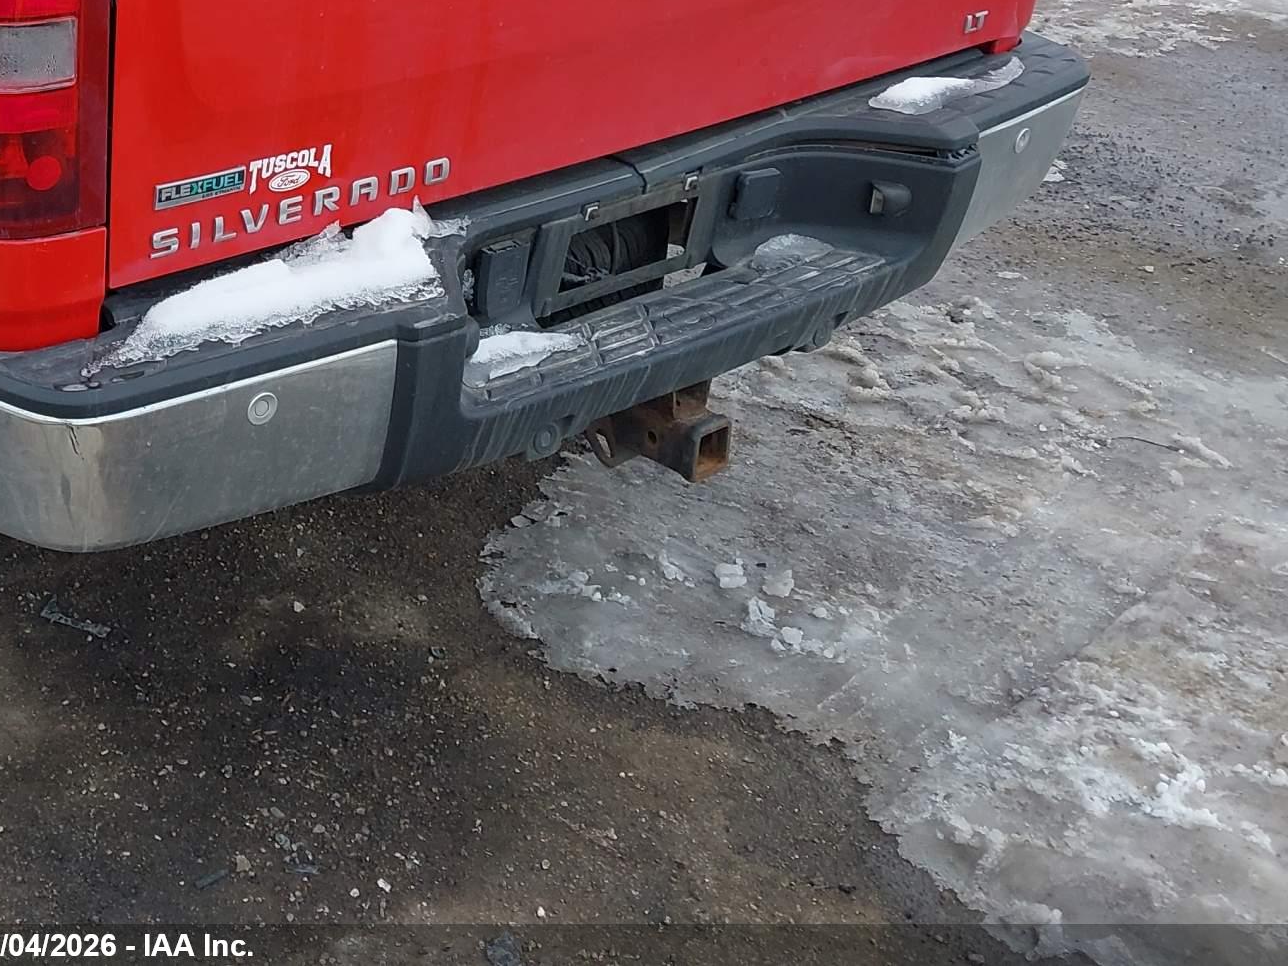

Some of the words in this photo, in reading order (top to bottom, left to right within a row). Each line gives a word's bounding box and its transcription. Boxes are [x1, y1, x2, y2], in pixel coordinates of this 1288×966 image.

[963, 10, 989, 34] LT
[249, 144, 333, 195] TUSCOLA
[149, 157, 451, 260] SILVERADO
